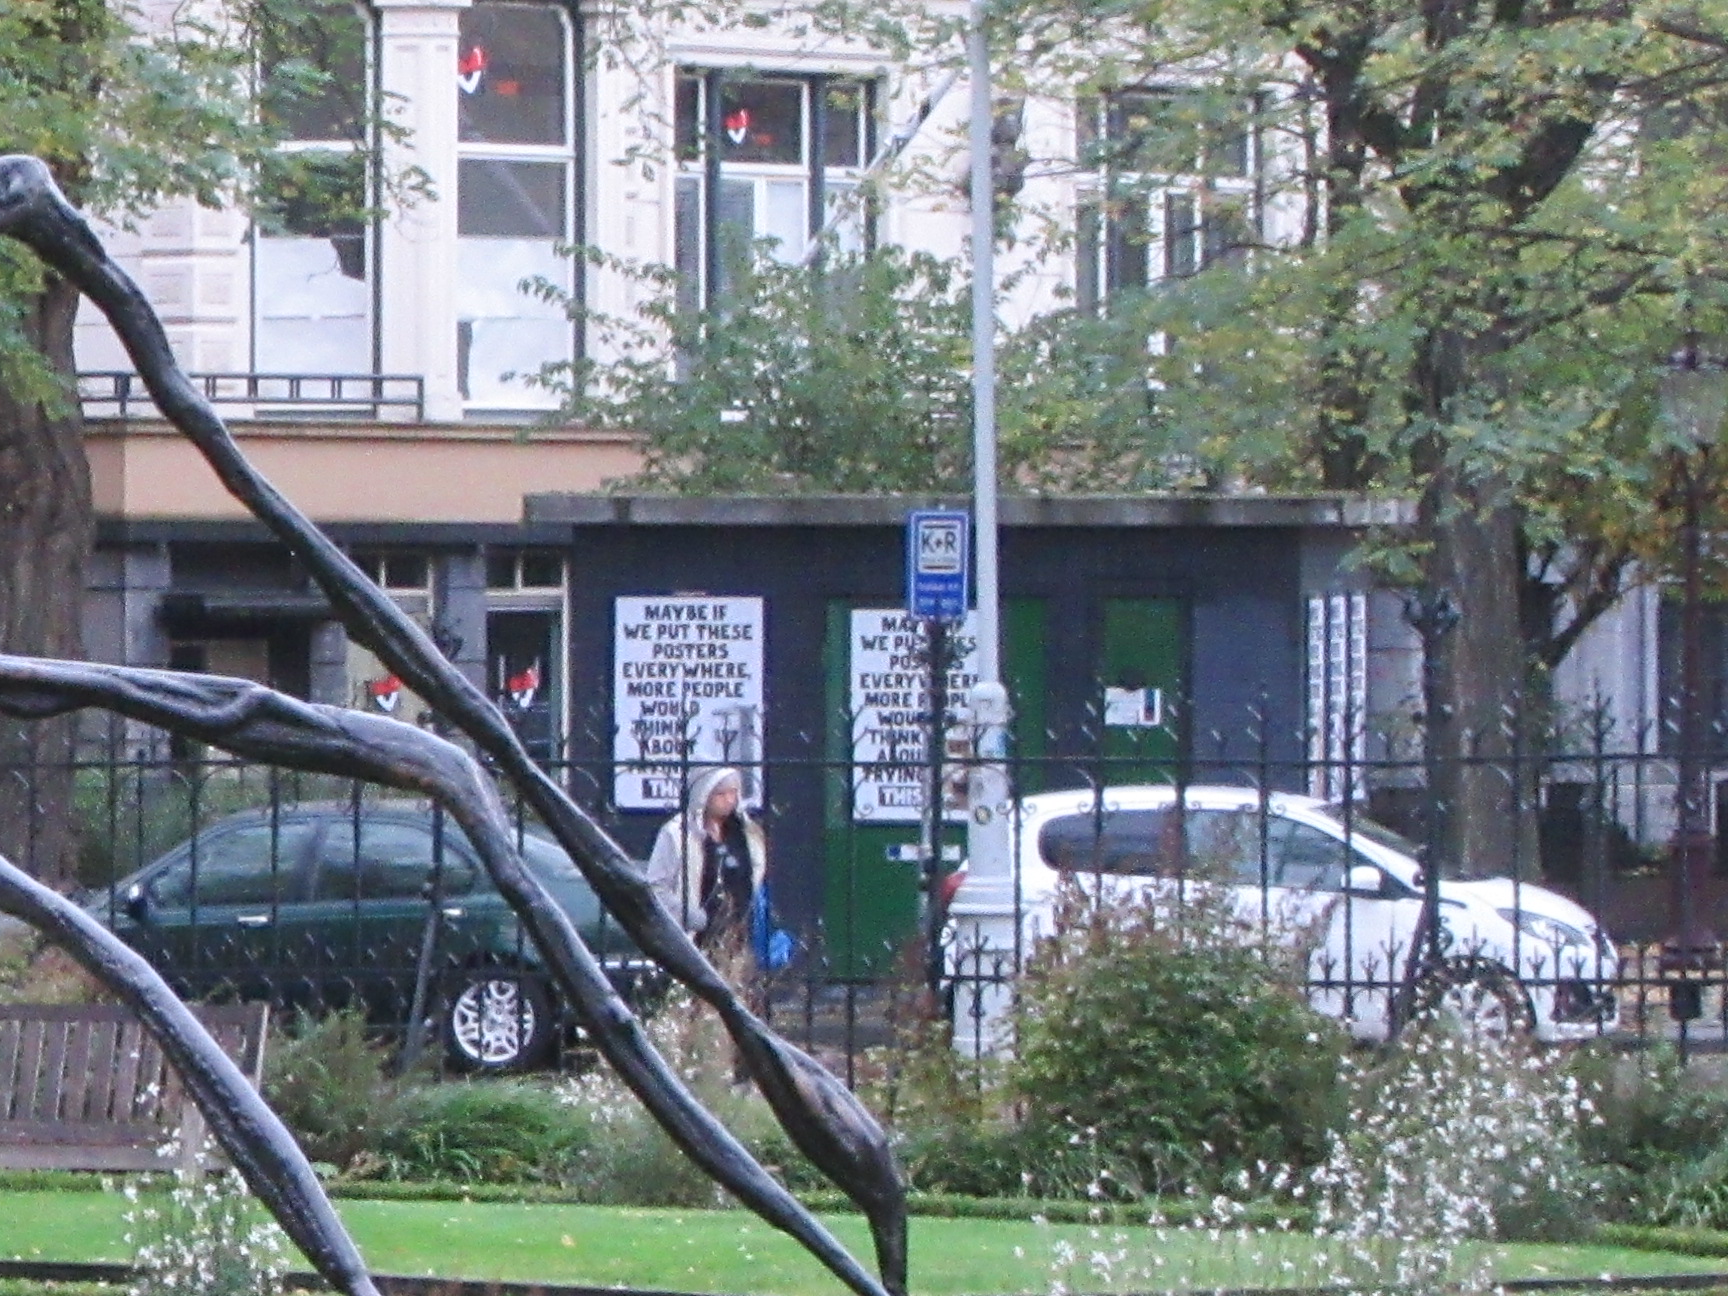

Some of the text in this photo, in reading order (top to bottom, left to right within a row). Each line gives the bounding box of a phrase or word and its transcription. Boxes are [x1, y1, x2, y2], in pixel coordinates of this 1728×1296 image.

[921, 531, 956, 553] K+R
[644, 604, 727, 621] MAYBE IF
[623, 624, 753, 640] WE PUT THESE
[653, 643, 729, 659] POSTERS
[860, 635, 889, 651] WE
[622, 662, 752, 680] EVERYWHERE,
[627, 681, 744, 698] MORE PEOPLE
[864, 692, 913, 707] MORE
